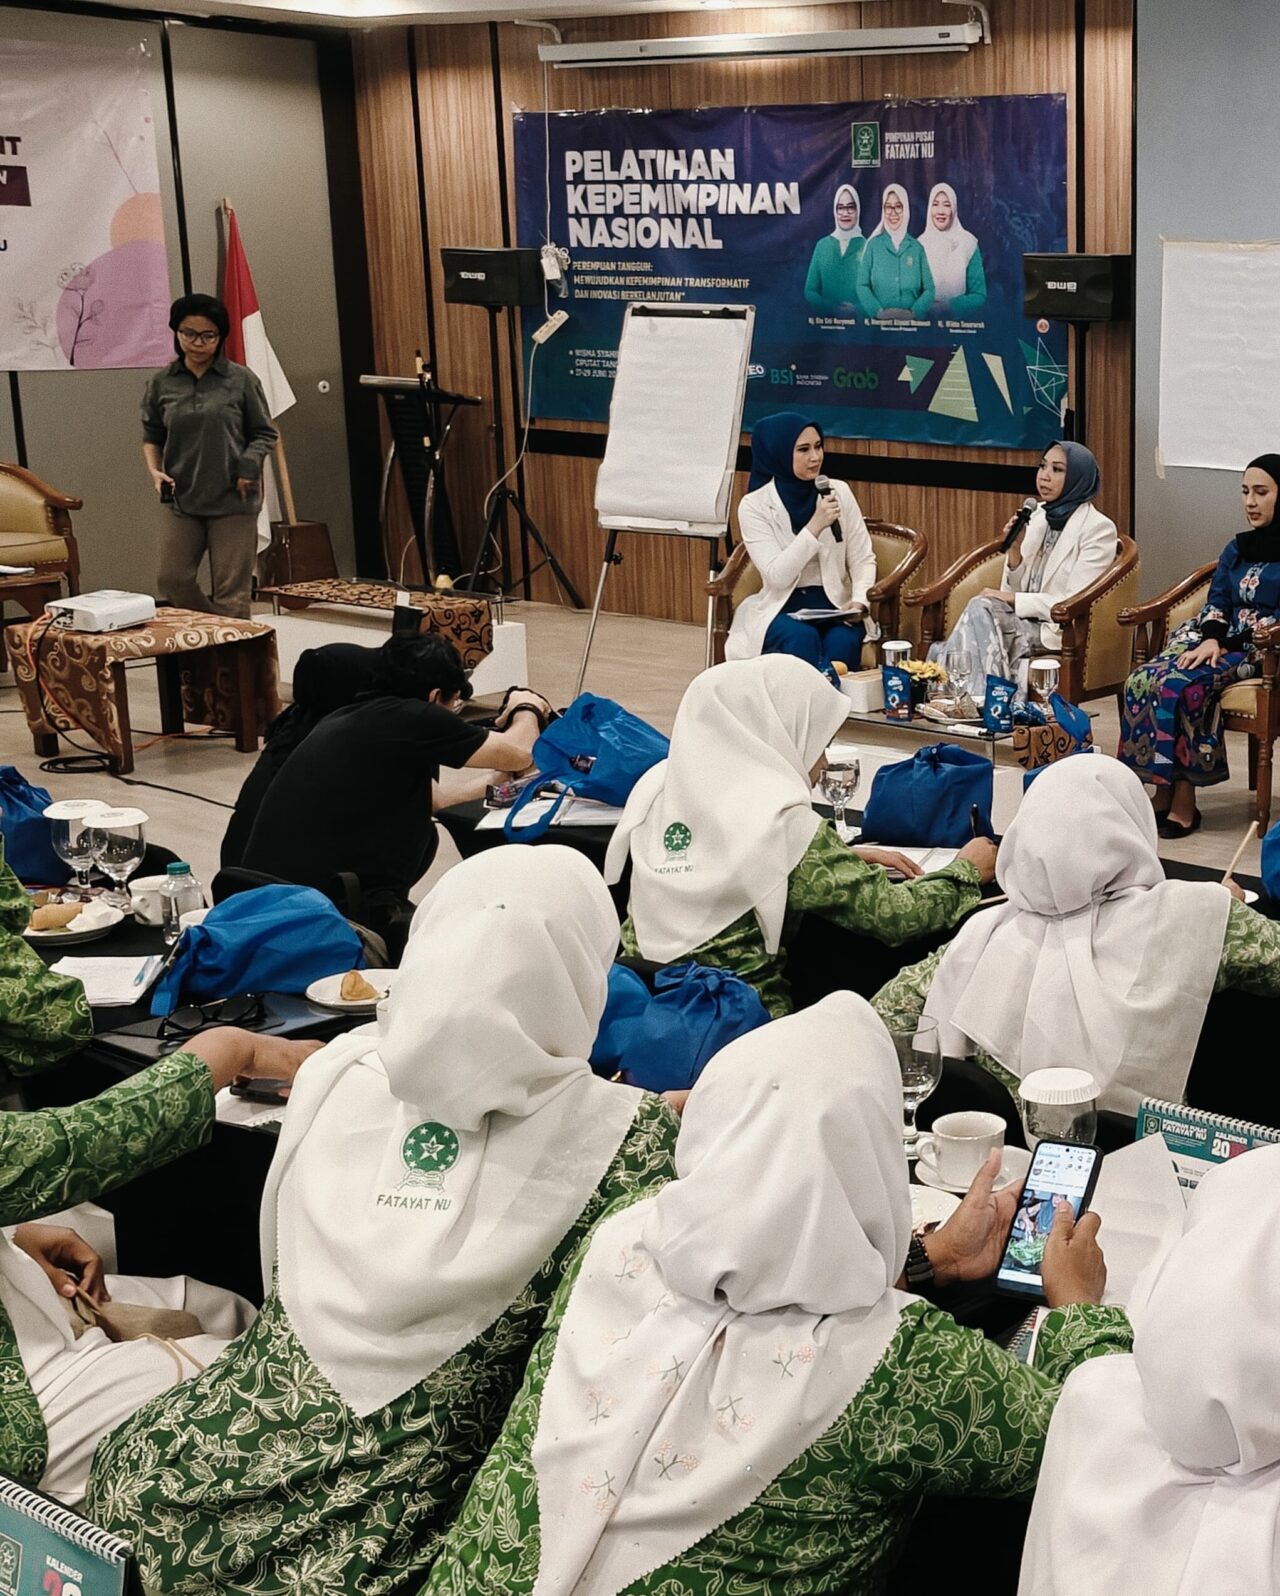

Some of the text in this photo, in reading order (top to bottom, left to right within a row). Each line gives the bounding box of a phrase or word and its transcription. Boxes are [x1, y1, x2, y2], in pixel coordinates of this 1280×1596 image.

[885, 142, 935, 160] FATAYAT NU
[565, 148, 735, 181] PELATIHAN
[566, 182, 800, 215] KEPEMIMPINAN
[568, 217, 723, 249] NASIONAL
[684, 277, 750, 289] TRANSFORMATIF
[575, 289, 589, 298] DAN
[747, 364, 765, 375] EO
[833, 367, 879, 389] Grab
[376, 1194, 452, 1211] FATAYAT NU
